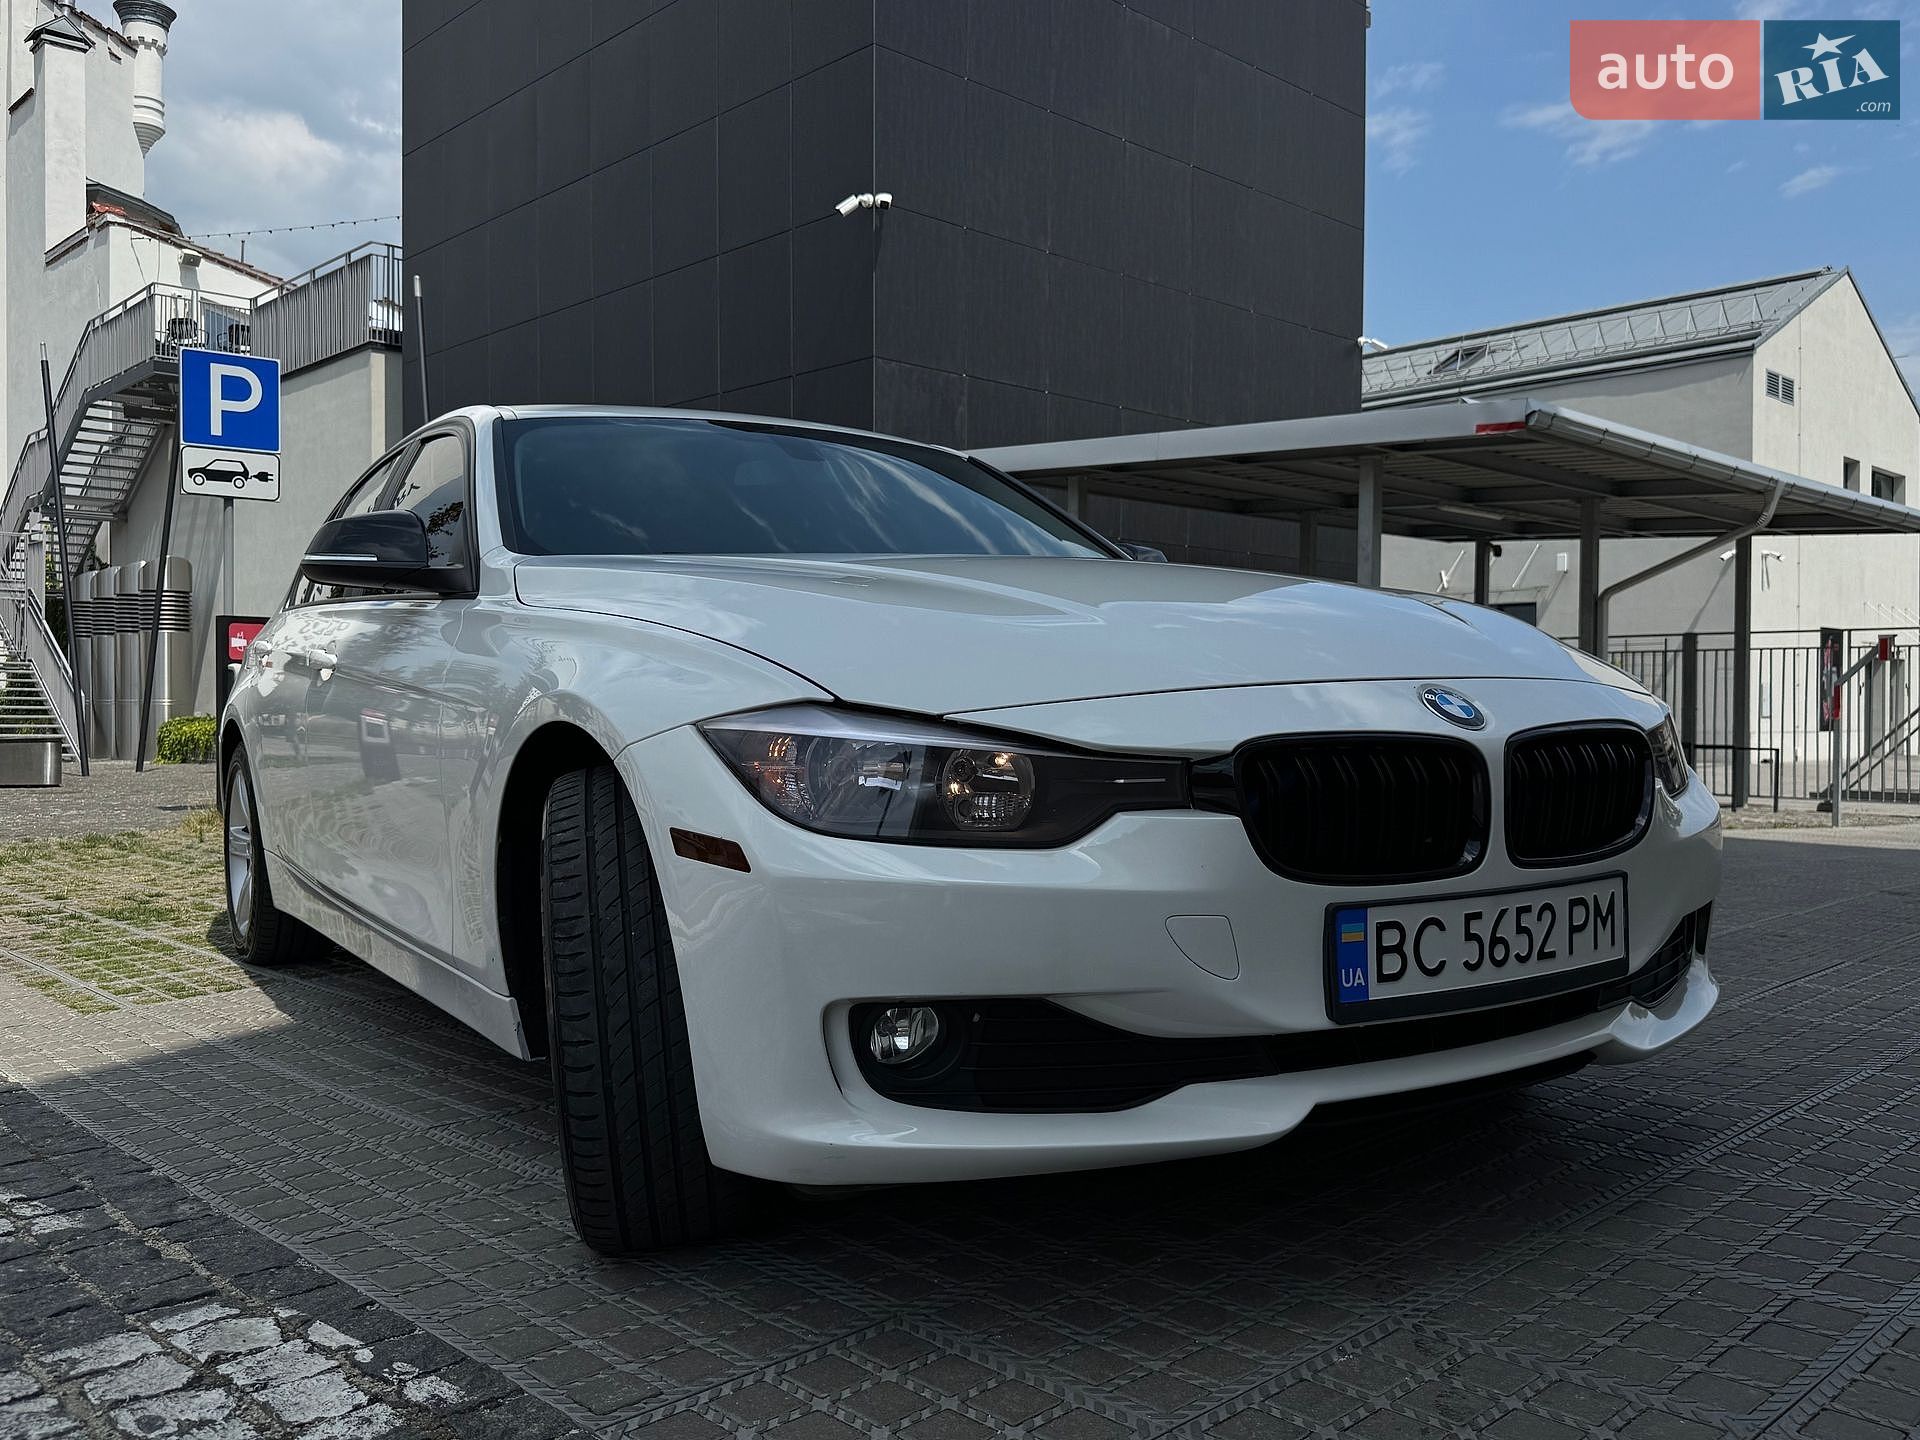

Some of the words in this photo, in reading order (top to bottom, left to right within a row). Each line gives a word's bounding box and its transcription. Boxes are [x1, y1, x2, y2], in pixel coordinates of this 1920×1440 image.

[210, 363, 262, 436] P
[1375, 917, 1447, 984] BC
[1463, 902, 1556, 972] 5652
[1568, 891, 1616, 956] PM
[1342, 968, 1366, 988] UA
